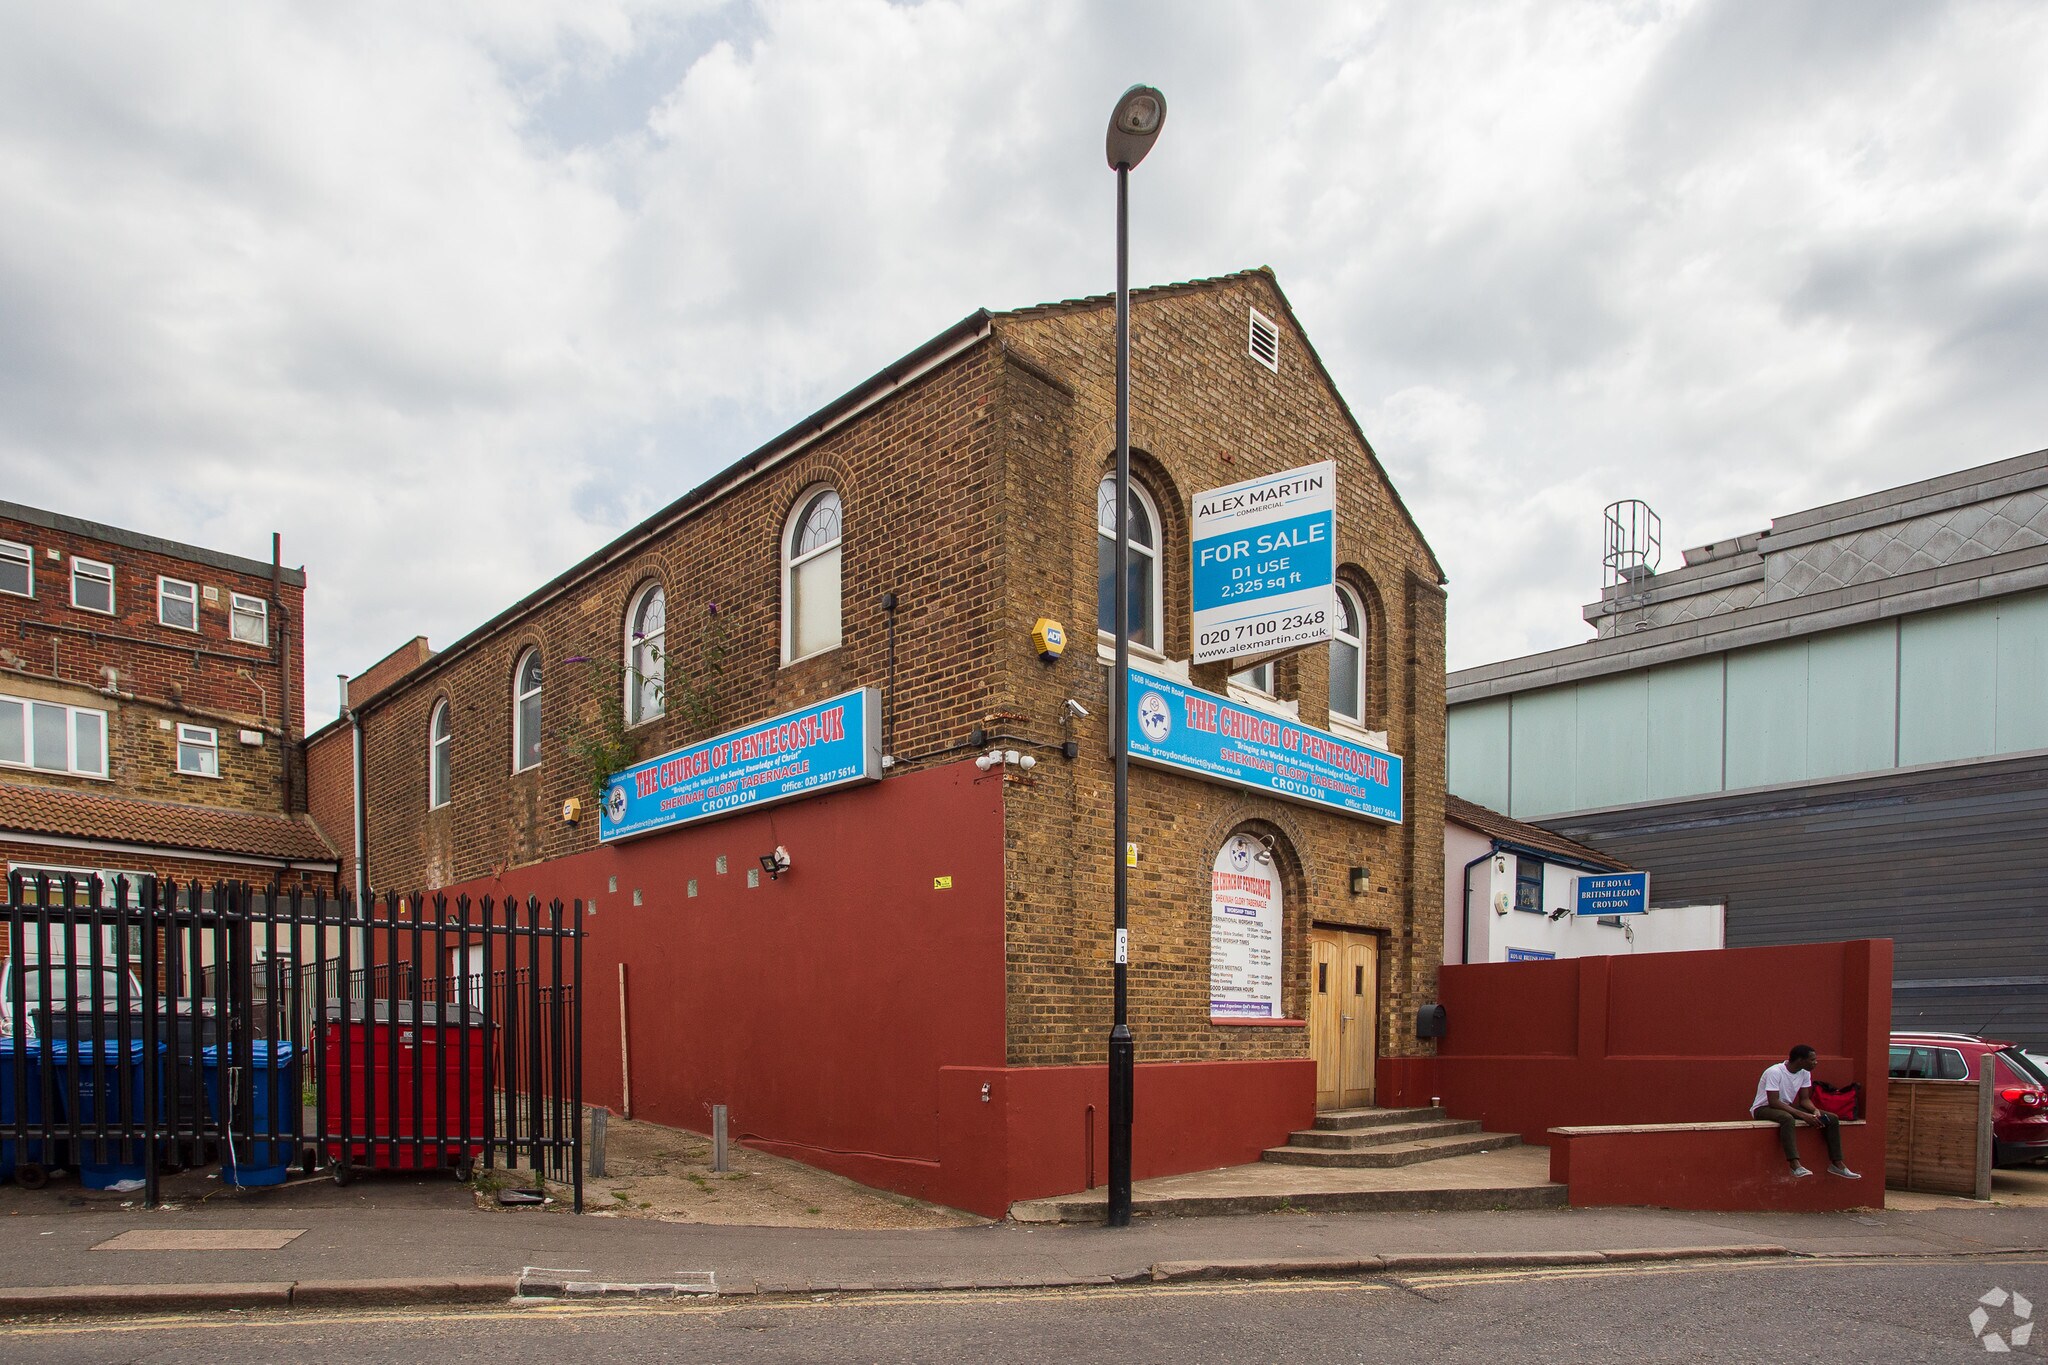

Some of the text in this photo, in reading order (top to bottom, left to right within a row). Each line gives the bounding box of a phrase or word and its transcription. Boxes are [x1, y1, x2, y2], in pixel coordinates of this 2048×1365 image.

[1199, 476, 1323, 518] ALEX MARTIN
[1236, 501, 1284, 517] COMMERCIAL
[1200, 522, 1325, 567] FOR SALE
[1232, 557, 1290, 580] D1 USE
[1221, 571, 1301, 598] 2,325 sq ft
[1048, 631, 1061, 642] ADT
[1200, 611, 1325, 646] 020 7100 2348
[1198, 628, 1326, 659] www.alexmartin.co.uk
[1144, 678, 1170, 693] Handcroft
[1171, 686, 1184, 698] Road
[636, 705, 844, 799] THE CHURCH OF PENTECOST-UK
[1185, 694, 1389, 787] THE CHURCH OF PENTECOST-UK
[701, 776, 714, 786] World
[729, 768, 745, 778] Saving
[746, 760, 773, 774] Knowledge
[775, 756, 780, 766] of
[1131, 740, 1241, 776] Email: gcroydondistrict@yahoo.co.uk
[1260, 748, 1268, 756] the
[1269, 750, 1284, 761] World
[1299, 760, 1314, 771] Saving
[1316, 764, 1338, 778] Knowledge
[1339, 772, 1344, 780] of
[660, 760, 809, 811] SHEKINAH GLORY TABERNACLE
[782, 765, 856, 792] Office: 020 3417 5614
[1221, 748, 1366, 799] SHEKINAH GLORY TABERNACLE
[702, 789, 756, 812] CROYDON
[1272, 777, 1325, 799] CROYDON
[1345, 799, 1396, 818] Office: 020 3417 5614
[1220, 872, 1236, 890] CHURCH
[1237, 874, 1242, 890] OF
[1582, 889, 1641, 899] BRITISH LEGION
[1607, 879, 1632, 888] ROYAL
[1216, 894, 1233, 903] SHEKINAH
[1592, 900, 1628, 908] CROYDON
